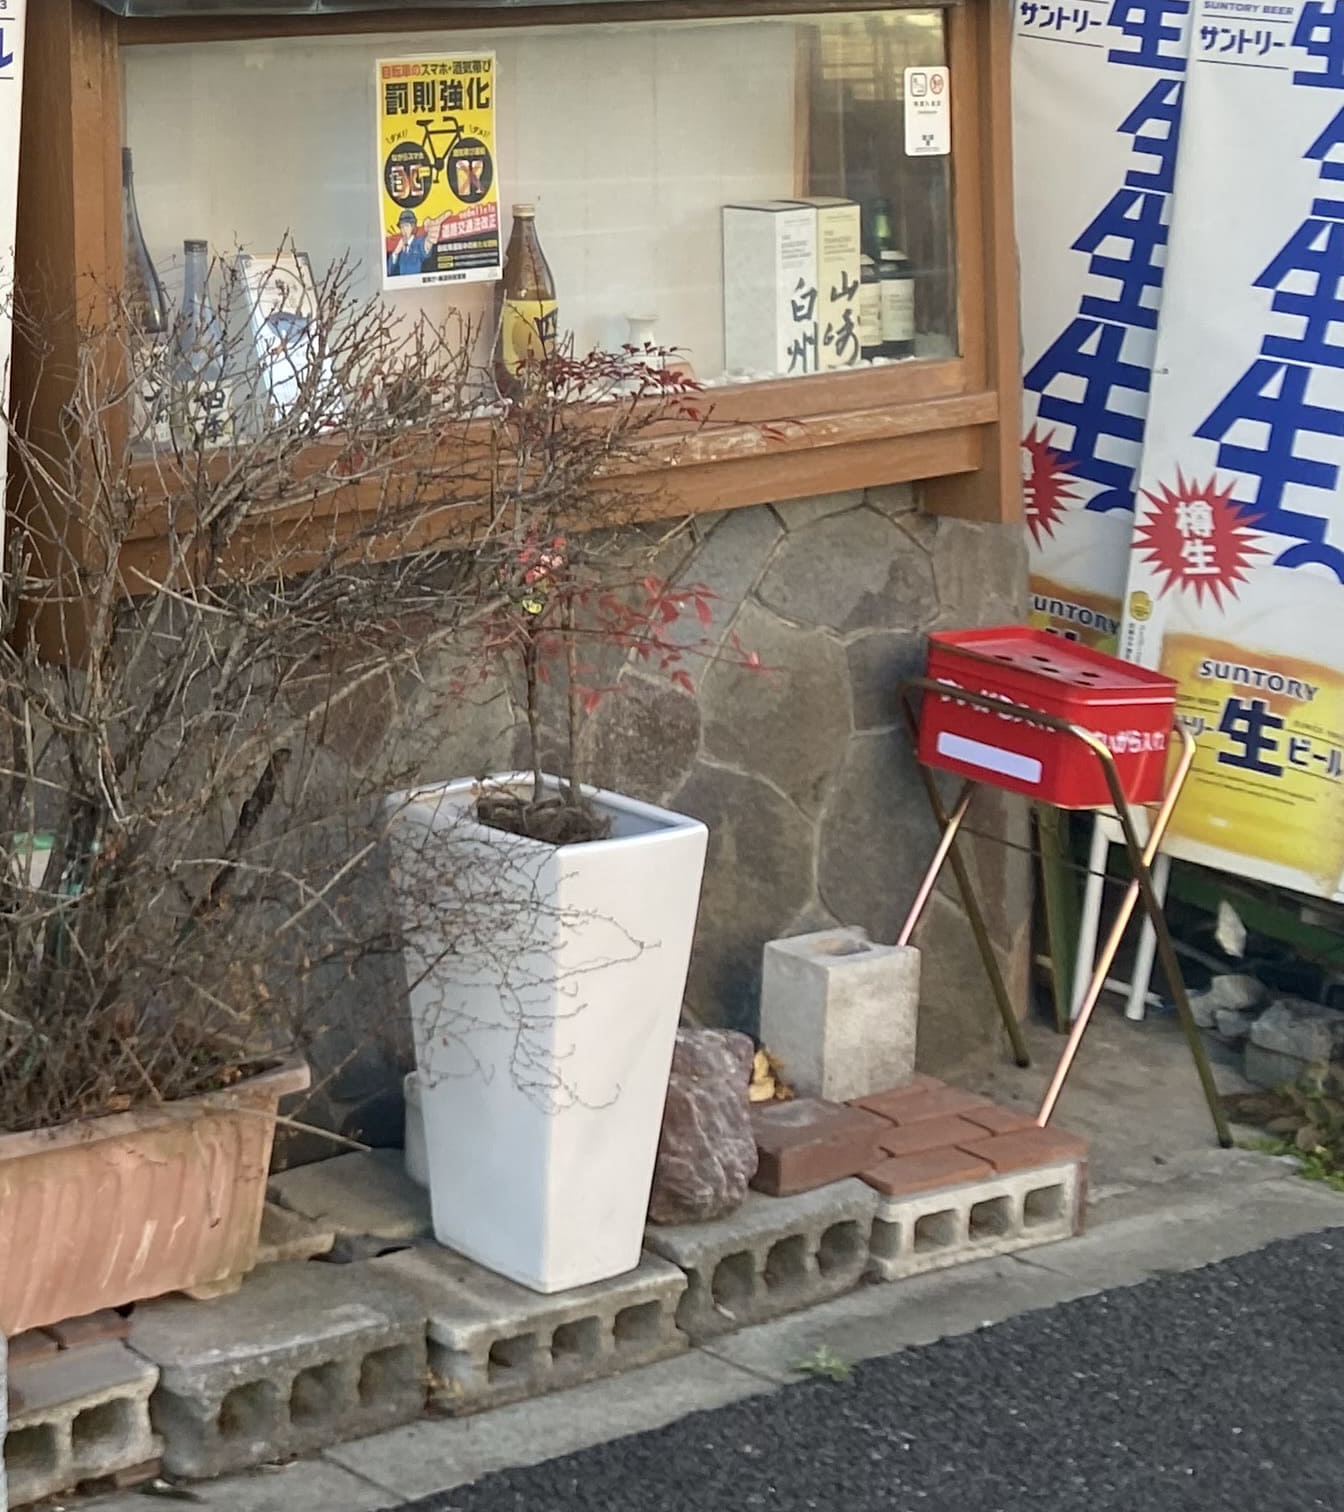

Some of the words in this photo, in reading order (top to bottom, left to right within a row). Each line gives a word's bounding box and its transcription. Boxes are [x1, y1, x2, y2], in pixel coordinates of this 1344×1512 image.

[1203, 0, 1259, 13] SUNTORY
[1262, 5, 1294, 16] BEER
[385, 76, 490, 116] 罰則強化
[787, 277, 819, 374] 白州
[1172, 500, 1222, 577] 樽生
[1034, 594, 1121, 636] UNTORY
[1199, 659, 1320, 701] SUNTORY
